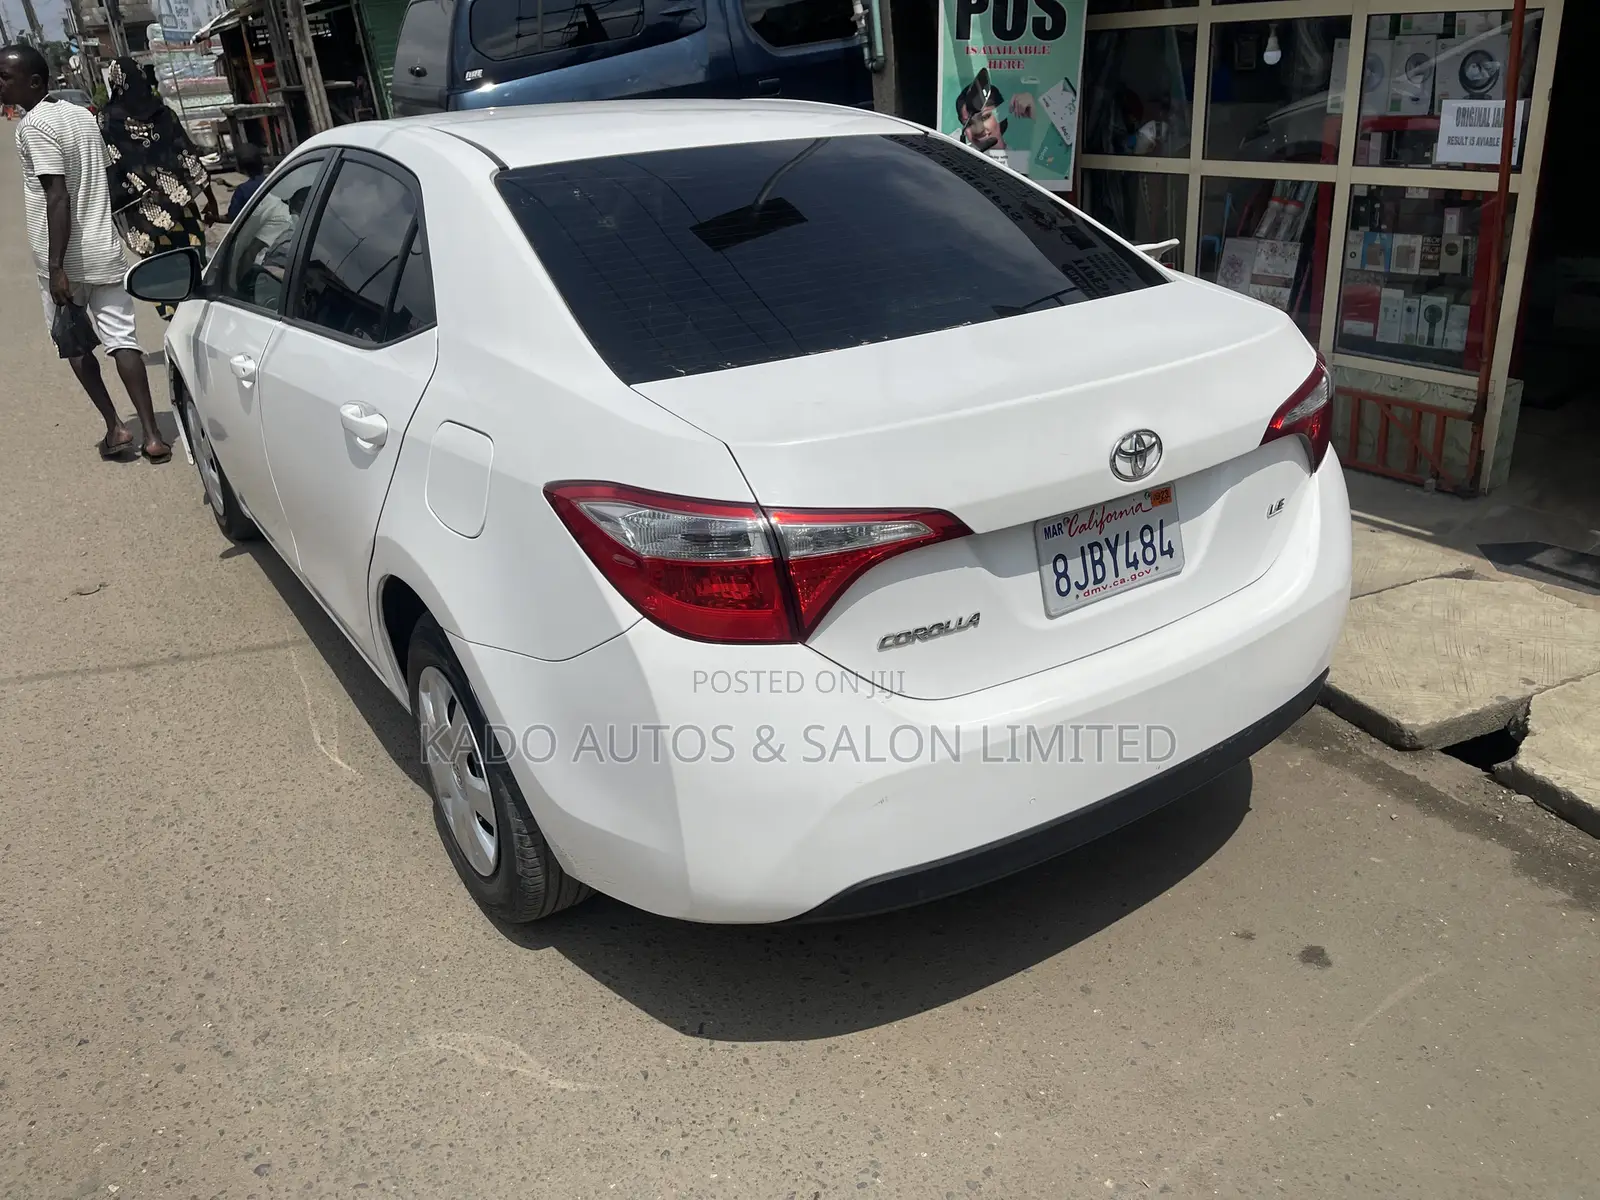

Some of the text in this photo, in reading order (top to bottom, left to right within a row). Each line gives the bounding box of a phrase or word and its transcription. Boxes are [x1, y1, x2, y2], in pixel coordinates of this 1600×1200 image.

[964, 45, 1051, 55] IS AVAILABLE
[987, 60, 1025, 70] HERE
[1455, 106, 1491, 128] ORIGINAL
[1446, 135, 1469, 147] RESULT
[1067, 499, 1153, 538] California
[1044, 522, 1064, 541] MAR
[1052, 518, 1175, 598] 8JBY484
[1082, 567, 1153, 598] dmv.ca.gov
[876, 611, 981, 652] COROLLA
